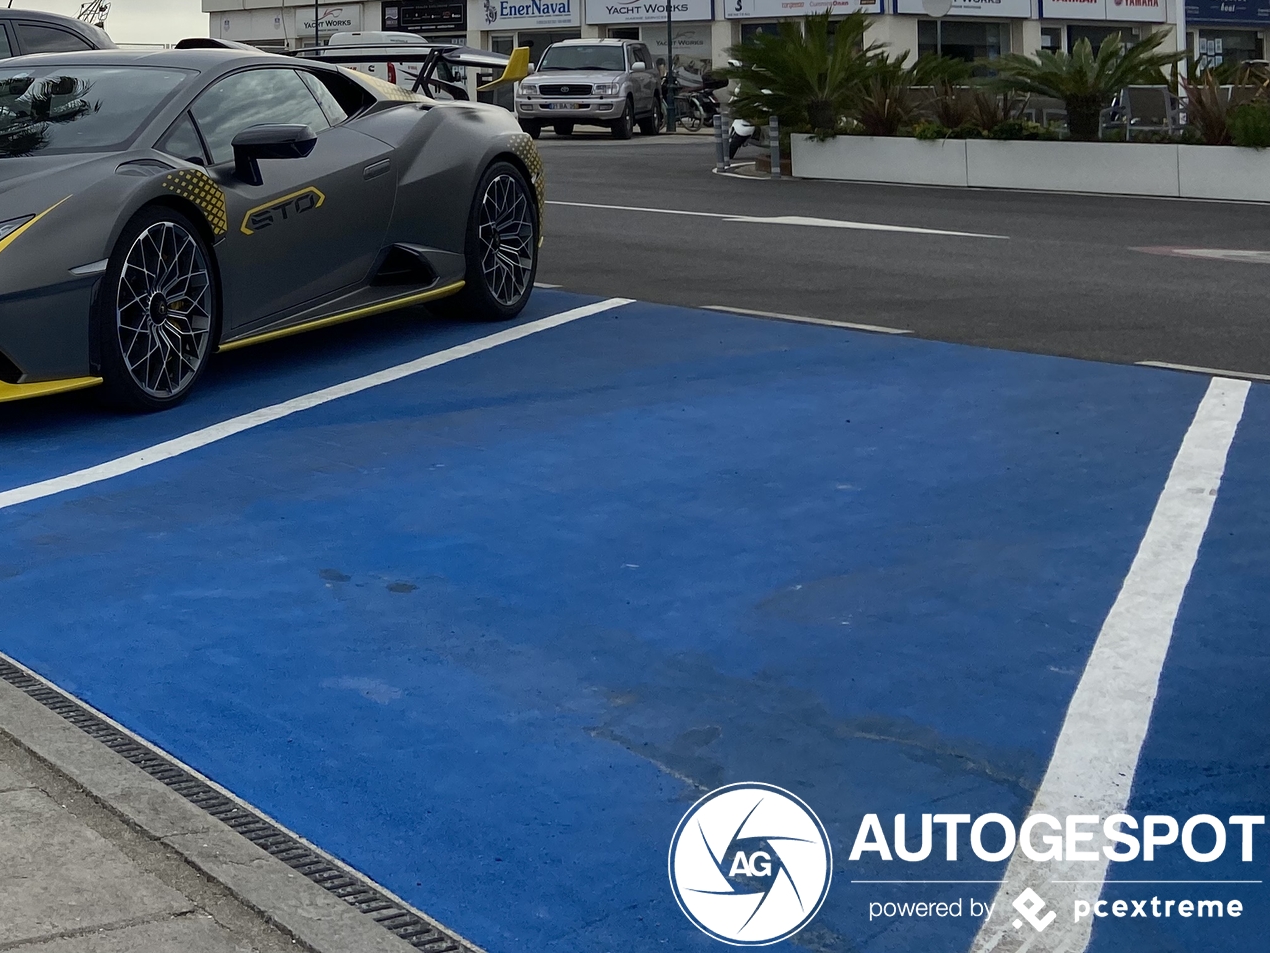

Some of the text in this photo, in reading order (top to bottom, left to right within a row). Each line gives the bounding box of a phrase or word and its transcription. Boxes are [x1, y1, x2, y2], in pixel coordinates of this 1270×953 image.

[605, 5, 642, 15] YACHT
[325, 19, 352, 27] WORKS
[251, 194, 315, 230] STO
